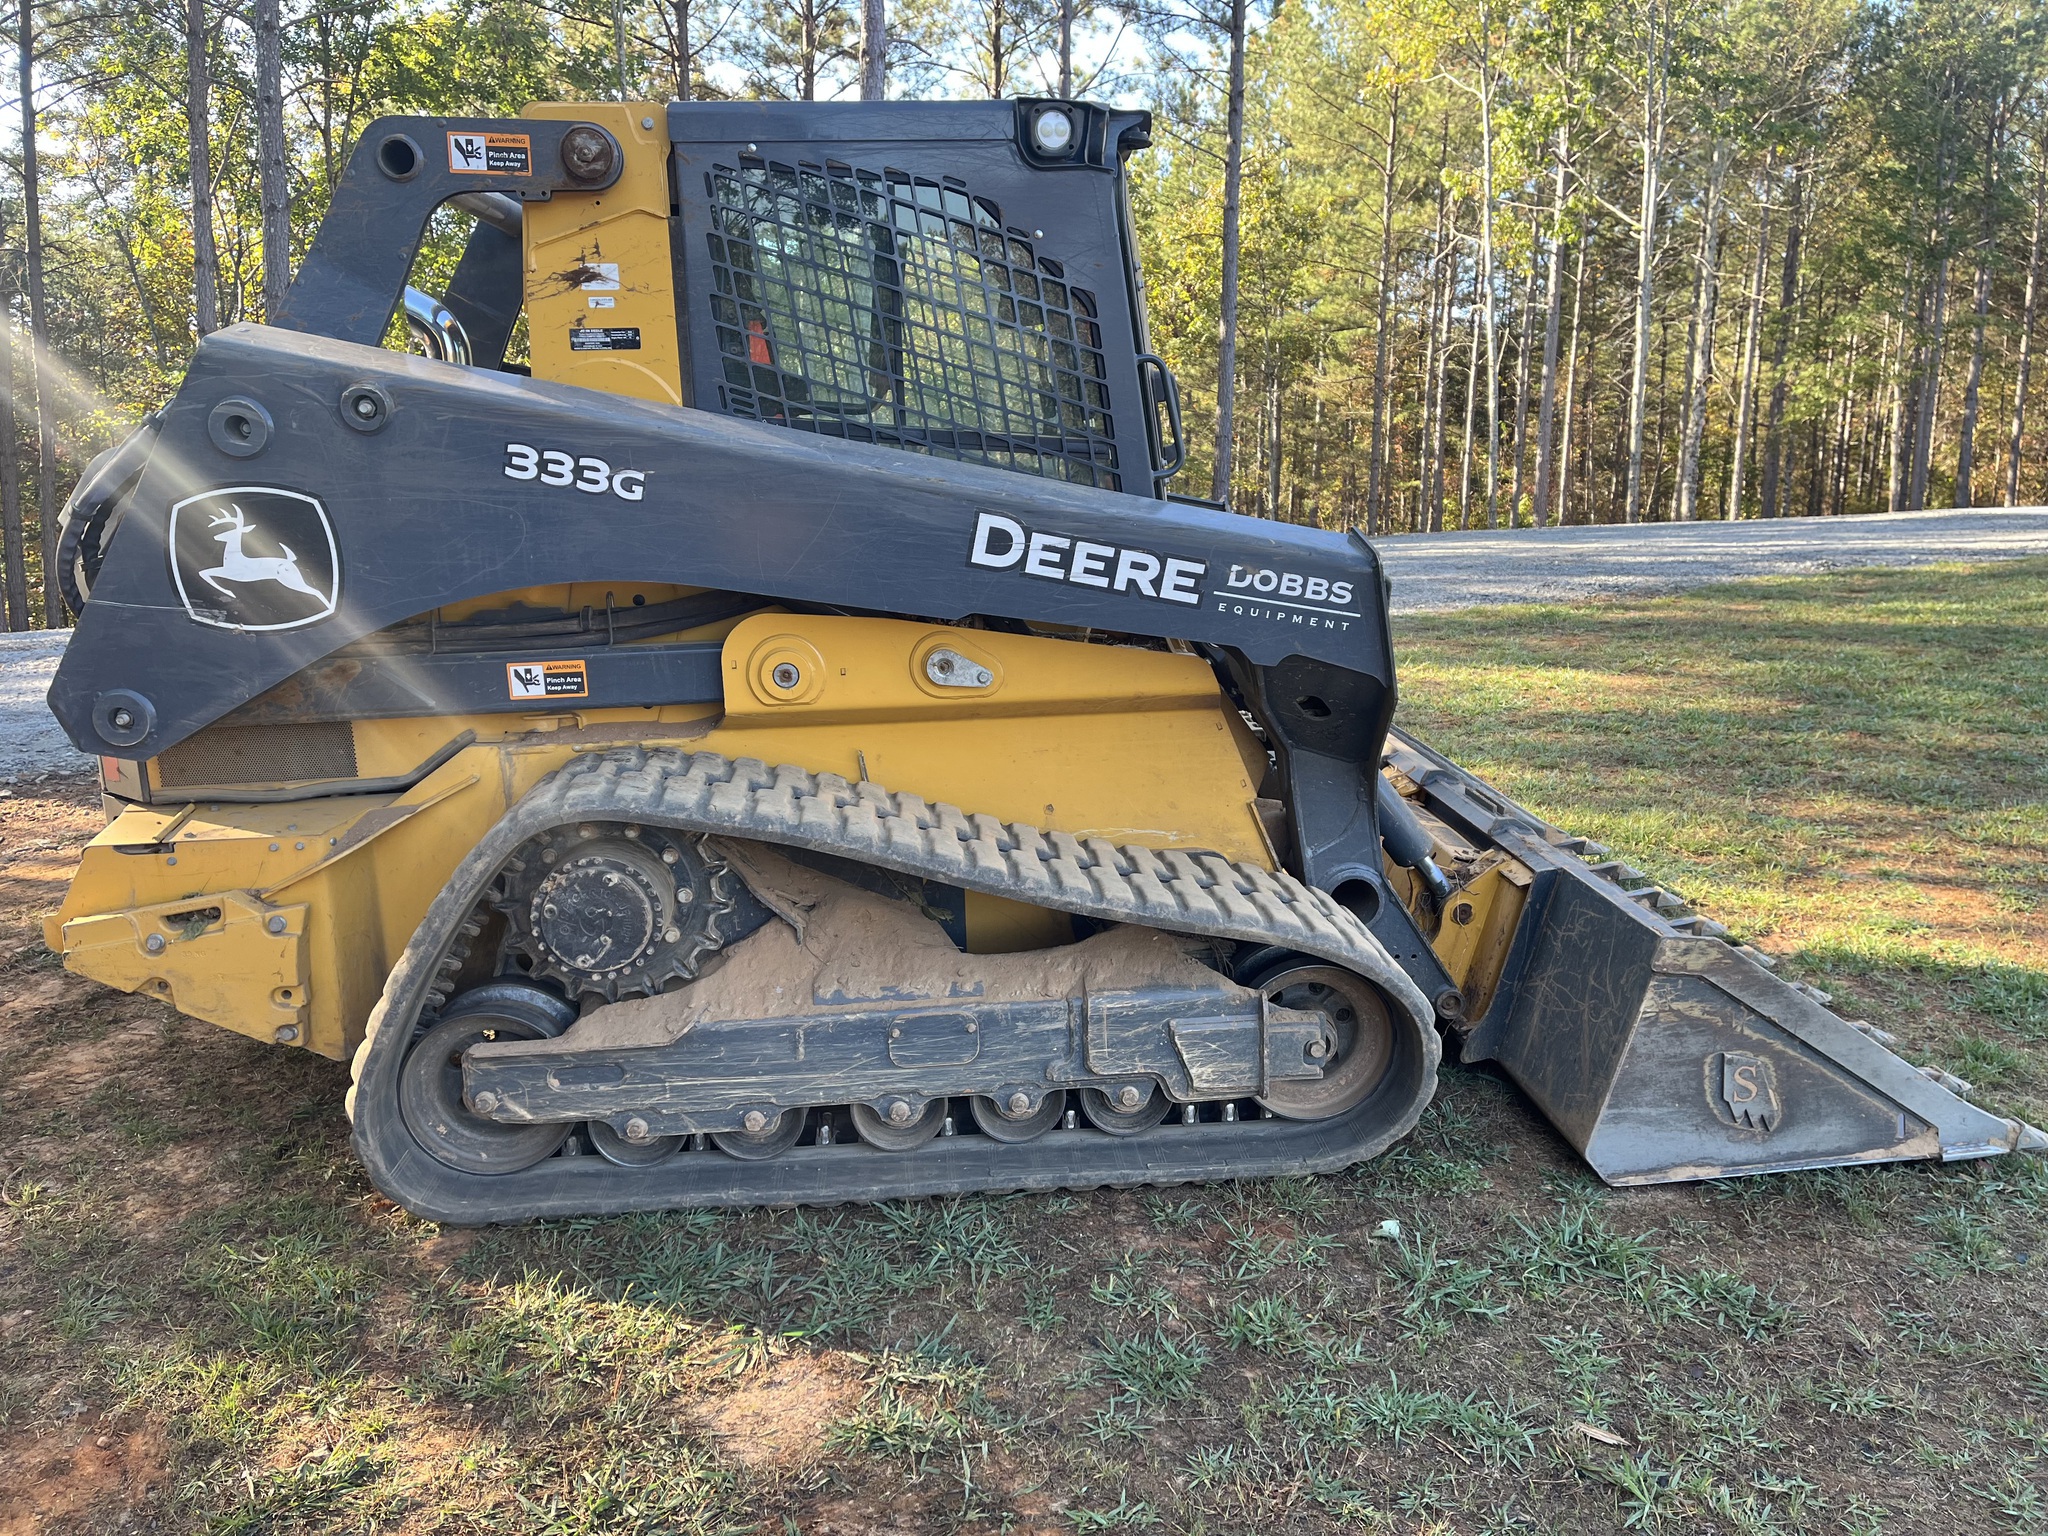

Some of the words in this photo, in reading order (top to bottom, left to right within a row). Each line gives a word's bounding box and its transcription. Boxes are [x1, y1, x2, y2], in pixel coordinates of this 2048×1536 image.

[504, 444, 645, 501] 333G
[971, 512, 1206, 605] DEERE
[1227, 564, 1354, 604] DOBBS
[1218, 602, 1350, 631] EQUIPMENT
[1733, 1065, 1758, 1103] S
